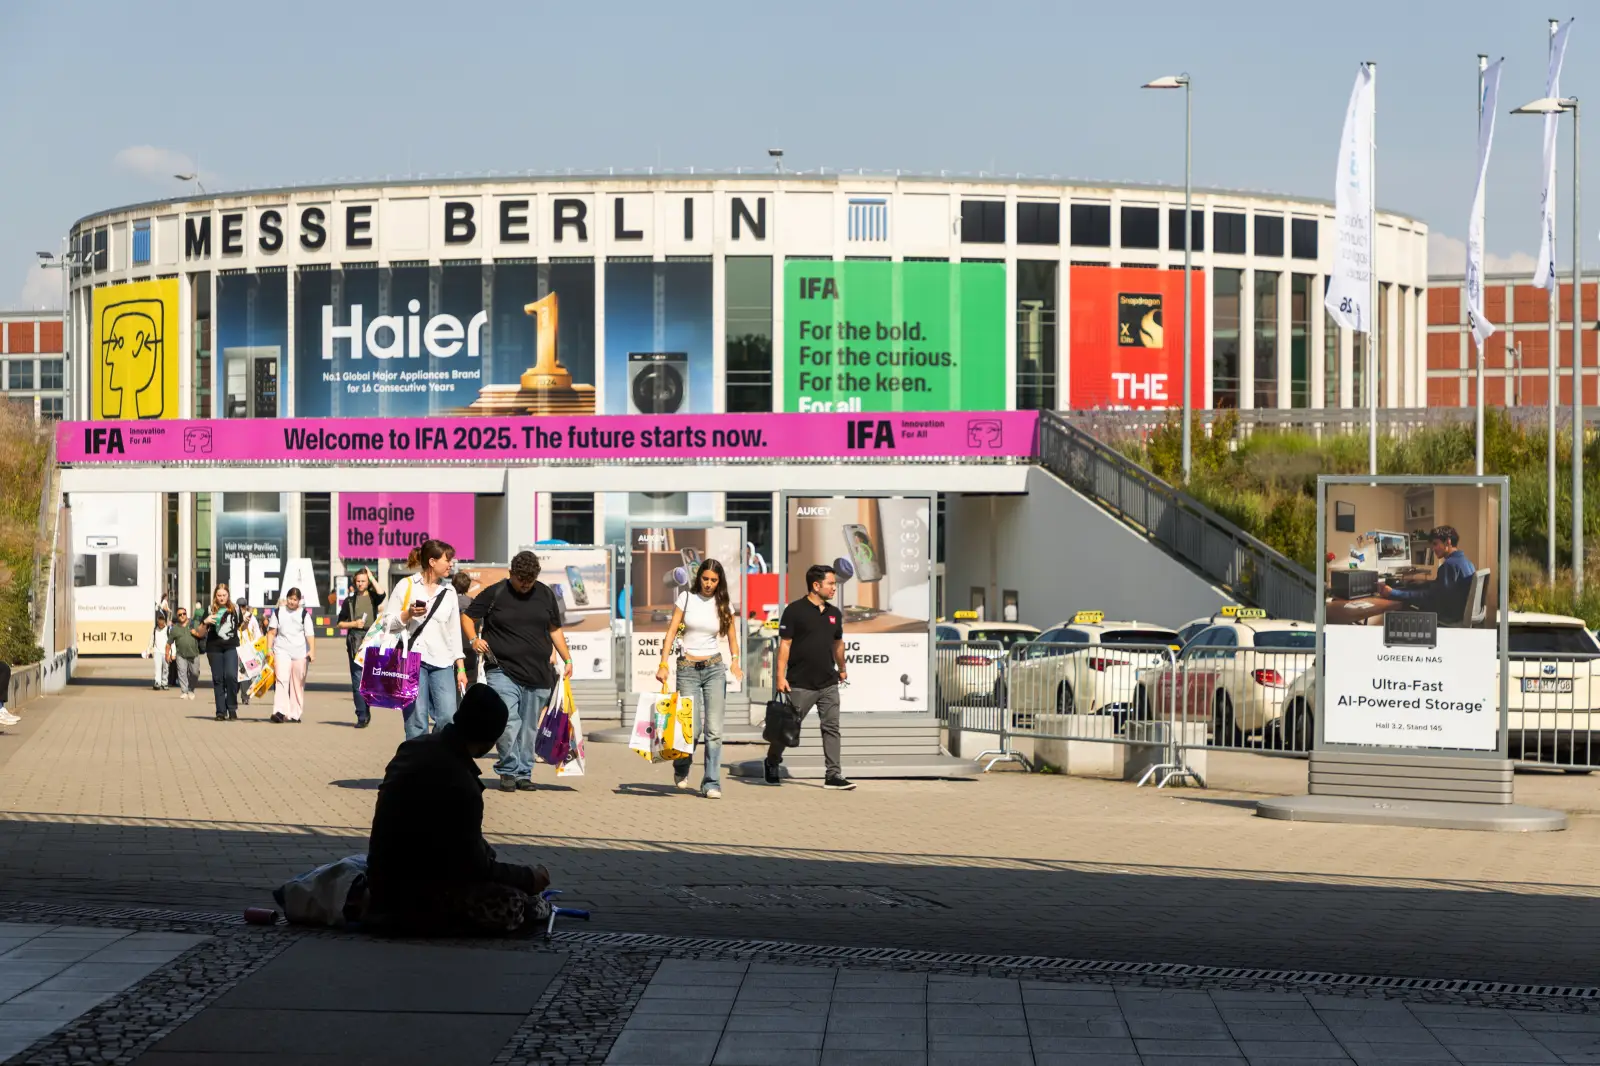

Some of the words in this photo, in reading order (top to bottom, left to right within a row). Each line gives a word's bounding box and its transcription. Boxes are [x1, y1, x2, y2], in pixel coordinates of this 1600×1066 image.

[185, 205, 373, 256] MESSE
[444, 197, 766, 243] BERLIN
[799, 277, 839, 299] IFA
[322, 298, 488, 360] Haier
[799, 320, 832, 341] For
[837, 321, 871, 341] the
[876, 321, 927, 341] bold.
[1120, 323, 1130, 336] X
[799, 346, 832, 366] For
[837, 347, 871, 367] the
[876, 347, 958, 367] curious.
[323, 372, 341, 381] No.1
[343, 371, 371, 381] Global
[373, 371, 398, 383] Major
[400, 370, 450, 382] Appliances
[451, 369, 480, 379] Brand
[799, 372, 832, 392] For
[837, 373, 871, 392] the
[876, 373, 932, 392] keen.
[347, 384, 359, 394] for
[362, 384, 372, 393] 16
[373, 382, 427, 393] Consecutive
[429, 382, 455, 393] Years
[1111, 372, 1168, 400] THE
[129, 427, 166, 435] Innovation
[901, 420, 945, 429] Innovation
[84, 428, 125, 454] IFA
[284, 428, 384, 450] Welcome
[389, 429, 410, 450] to
[415, 428, 448, 450] IFA
[453, 427, 517, 450] 2025.
[522, 426, 562, 449] The
[568, 426, 635, 449] future
[640, 427, 707, 448] starts
[712, 429, 768, 448] now.
[847, 420, 896, 449] IFA
[901, 430, 915, 439] For
[916, 430, 928, 439] All
[347, 502, 415, 525] Imagine
[796, 506, 832, 516] AUKEY
[347, 527, 374, 546] the
[638, 534, 666, 542] AUKEY
[225, 542, 237, 551] Visit
[238, 543, 252, 551] Haier
[253, 542, 279, 552] Pavilion,
[228, 558, 321, 608] IFA
[83, 632, 107, 642] Hall
[110, 632, 133, 642] 7.1a
[844, 641, 861, 651] UG
[845, 654, 890, 664] WERED
[1372, 678, 1444, 692] Ultra-Fast
[1337, 695, 1420, 709] AI-Powered
